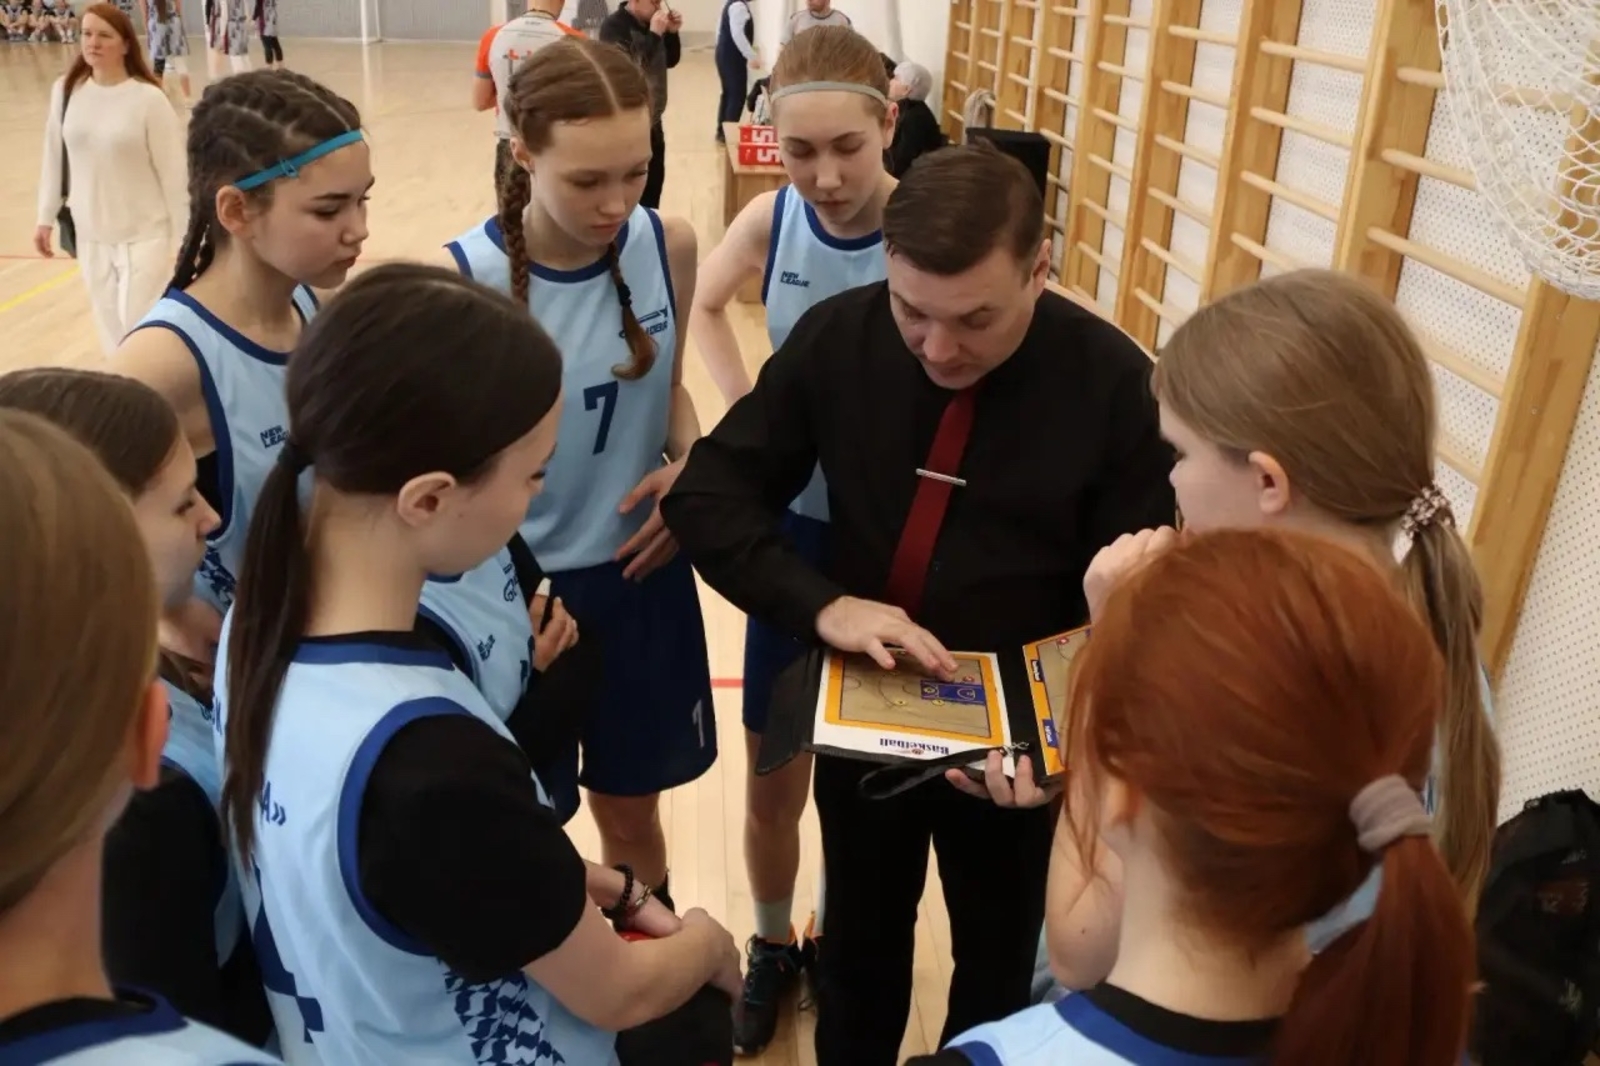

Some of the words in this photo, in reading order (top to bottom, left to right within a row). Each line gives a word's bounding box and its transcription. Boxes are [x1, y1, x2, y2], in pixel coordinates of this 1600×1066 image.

[781, 271, 799, 279] NEW
[584, 380, 619, 455] 7
[260, 425, 283, 439] NEW
[880, 738, 949, 755] Basketball
